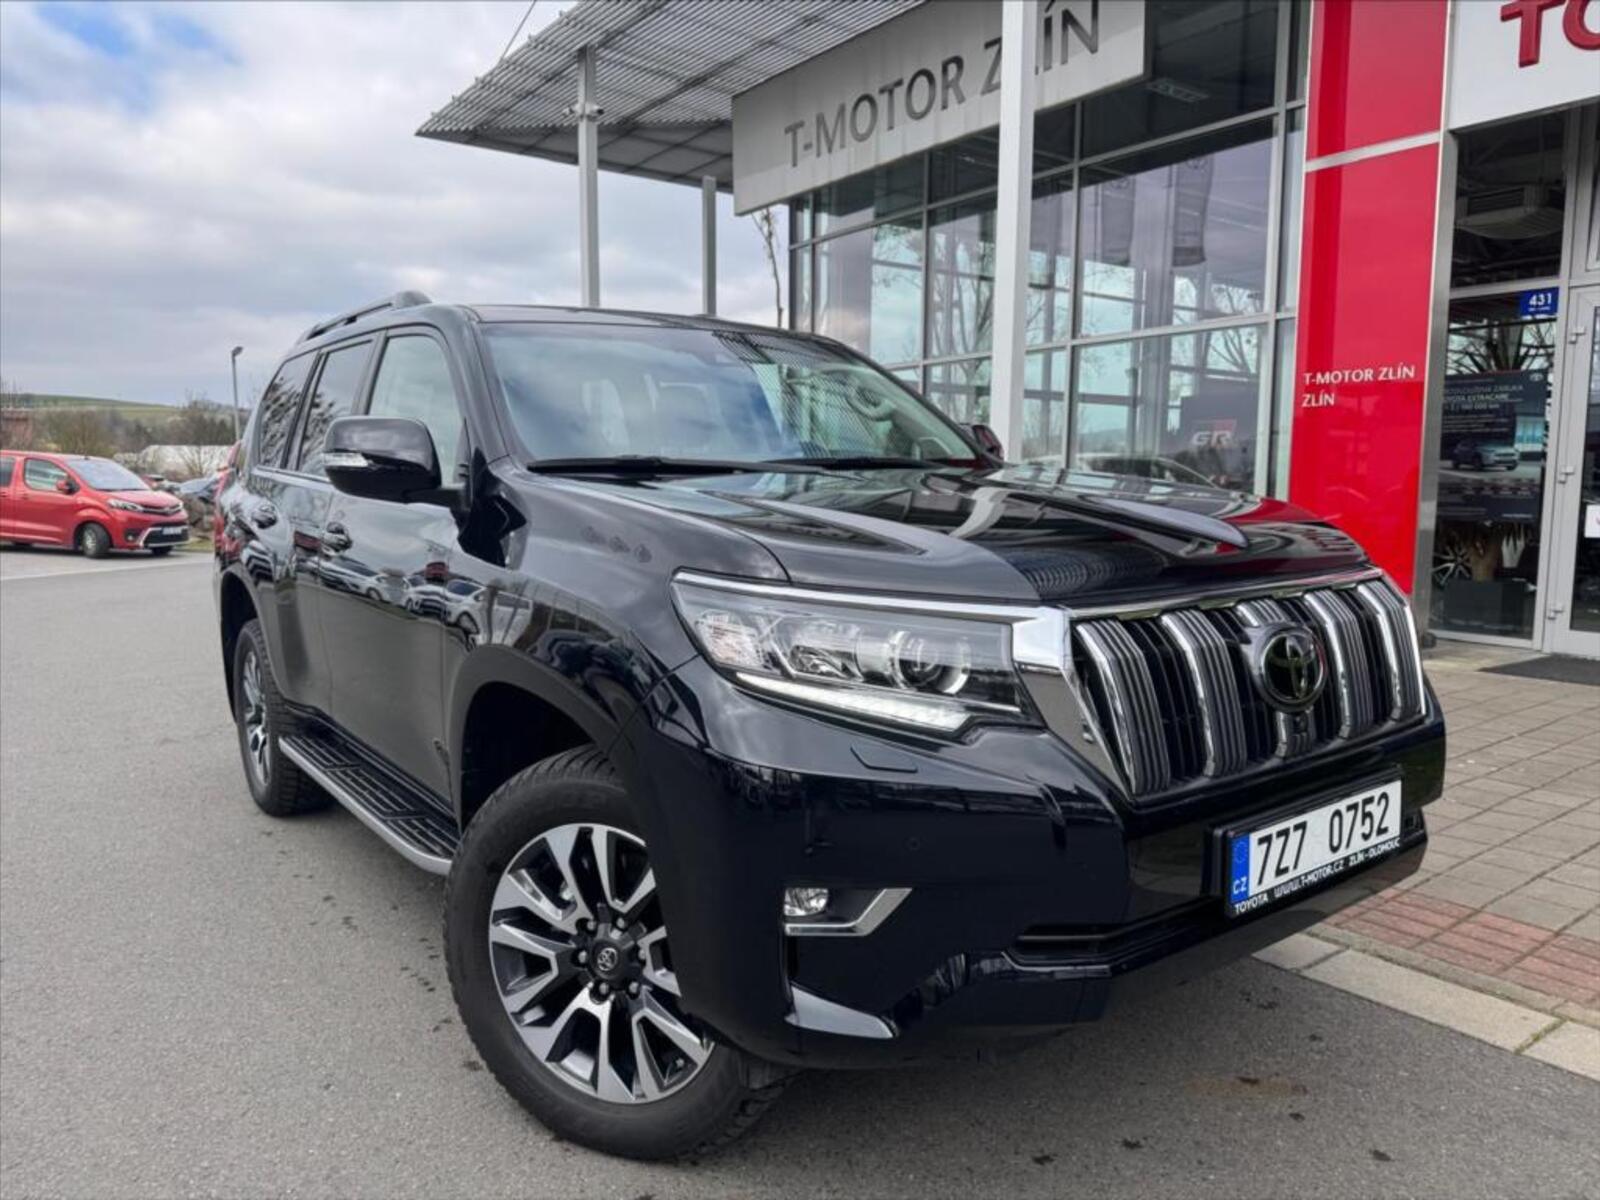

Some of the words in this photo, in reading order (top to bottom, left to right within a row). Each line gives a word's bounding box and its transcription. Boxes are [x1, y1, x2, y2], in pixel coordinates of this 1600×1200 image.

[784, 55, 967, 168] T-MOTOR
[981, 0, 1099, 96] ZÍN
[1529, 293, 1552, 306] 431
[1304, 368, 1374, 386] T-MOTOR
[1378, 361, 1416, 381] ZLÍN
[1302, 389, 1335, 408] ZLÍN
[1256, 820, 1308, 886] 7Z7
[1328, 791, 1390, 854] 0752
[1232, 875, 1248, 896] CZ
[1234, 892, 1269, 915] TOYOTA
